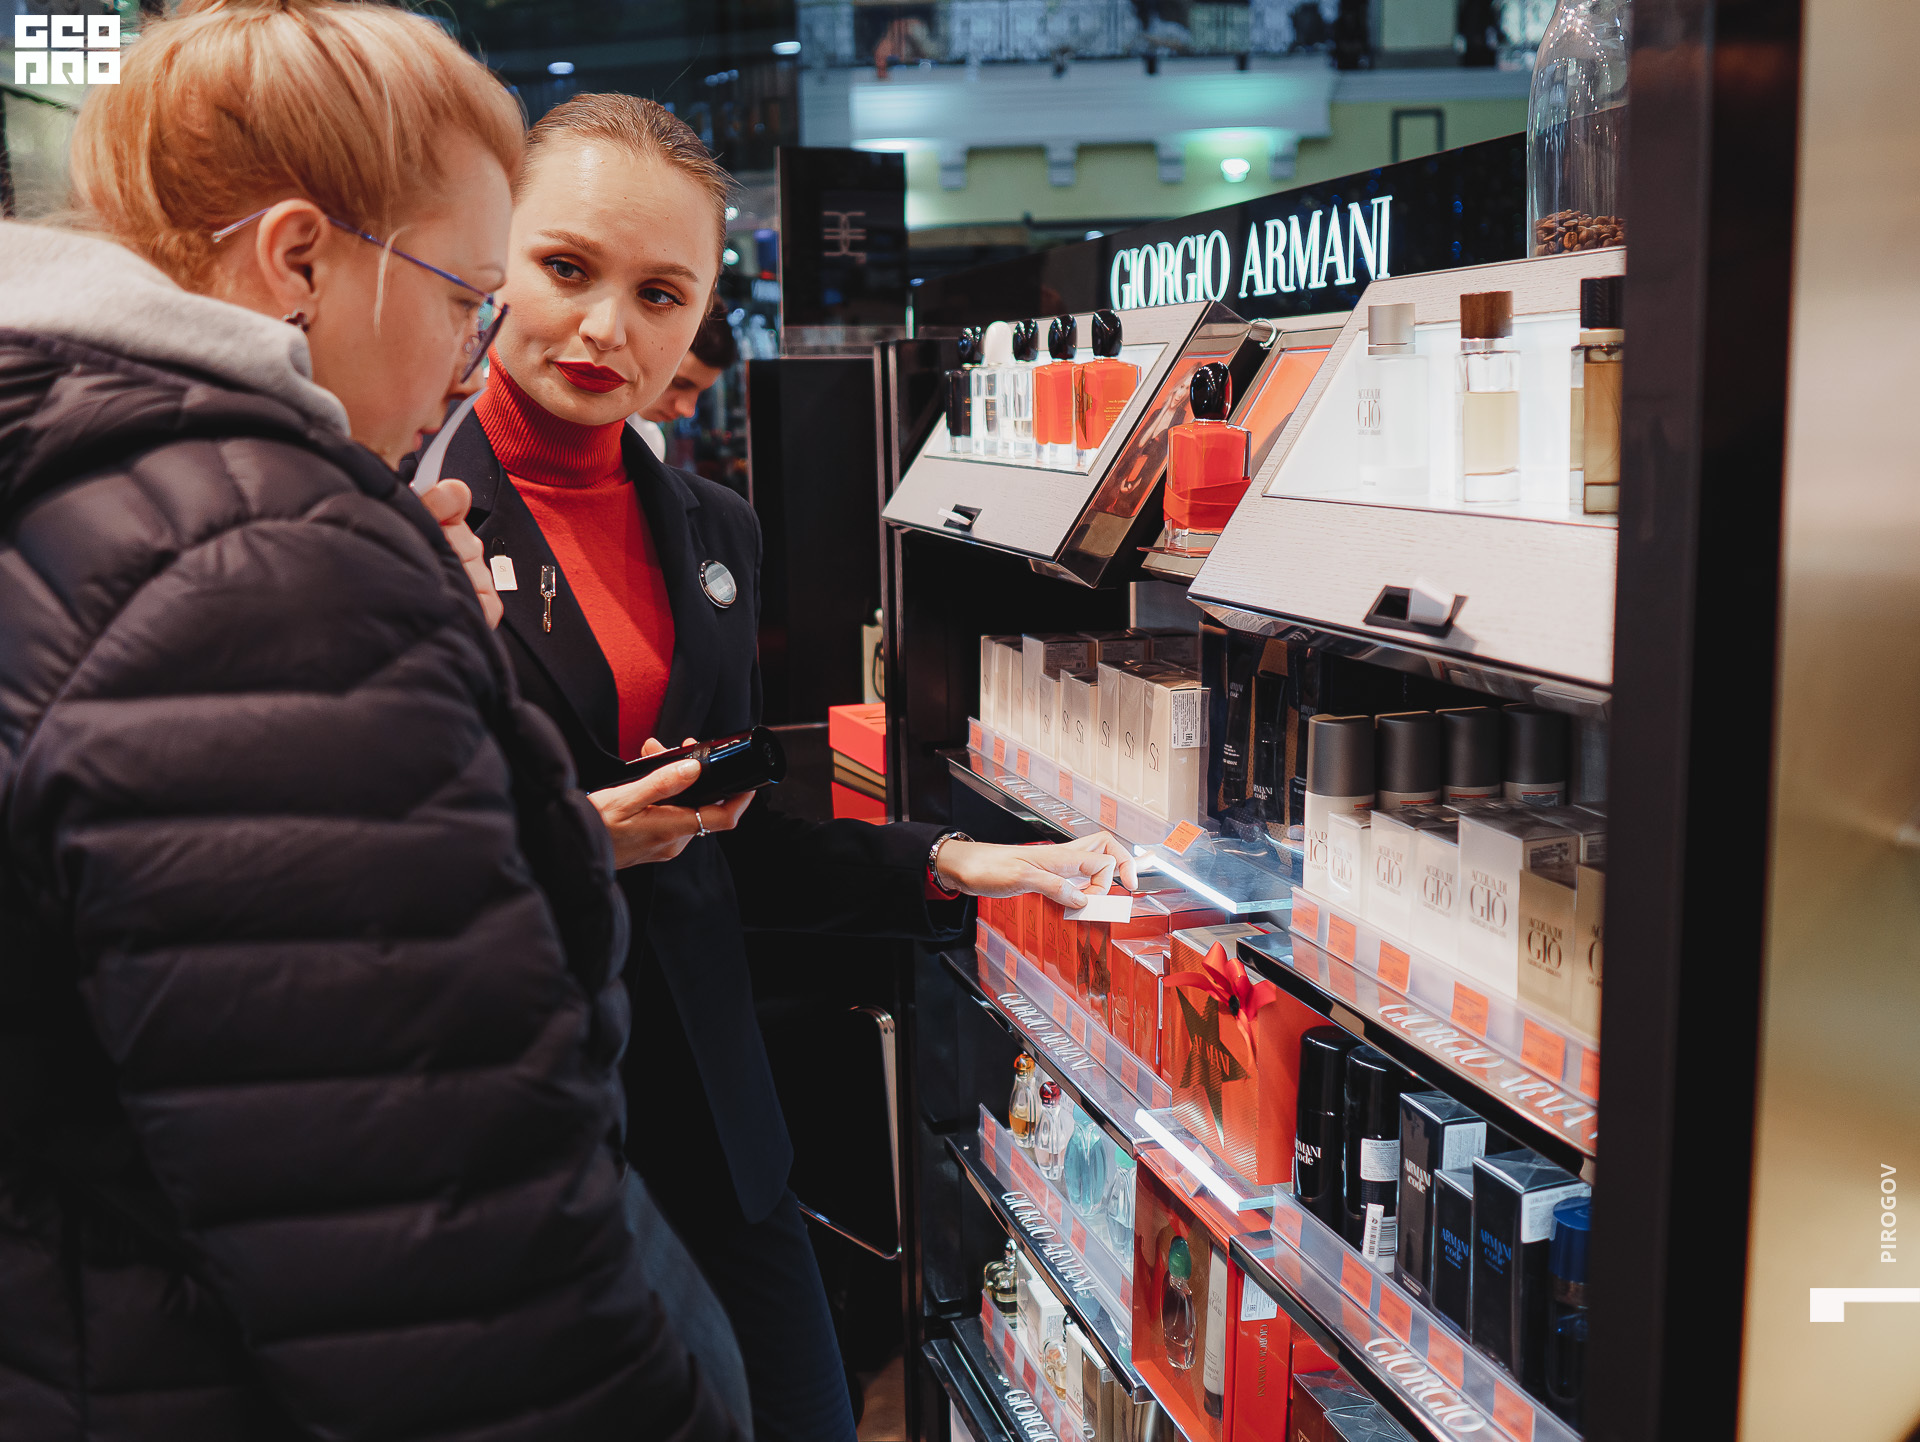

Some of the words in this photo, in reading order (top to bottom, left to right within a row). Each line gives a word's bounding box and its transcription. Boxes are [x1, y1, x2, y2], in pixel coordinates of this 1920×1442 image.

[1110, 229, 1231, 311] GIORGIO
[1238, 195, 1393, 299] ARMANI
[1423, 874, 1452, 911] GIÒ
[1470, 882, 1507, 929] GIÒ
[1527, 929, 1562, 970] GIÒ
[997, 992, 1053, 1030] GIORGIO
[1377, 1004, 1505, 1069] GIORGIO
[1404, 1158, 1432, 1187] ARMANI
[1407, 1175, 1427, 1194] code
[1001, 1191, 1057, 1240] GIORGIO
[1039, 1242, 1099, 1292] ARMANI
[1441, 1228, 1469, 1257] ARMANI
[1445, 1244, 1463, 1262] code
[1480, 1229, 1512, 1261] ARMANI
[1259, 1323, 1269, 1362] GIORGIO
[1258, 1364, 1267, 1398] ARMANI
[1365, 1337, 1487, 1433] GIORGIO
